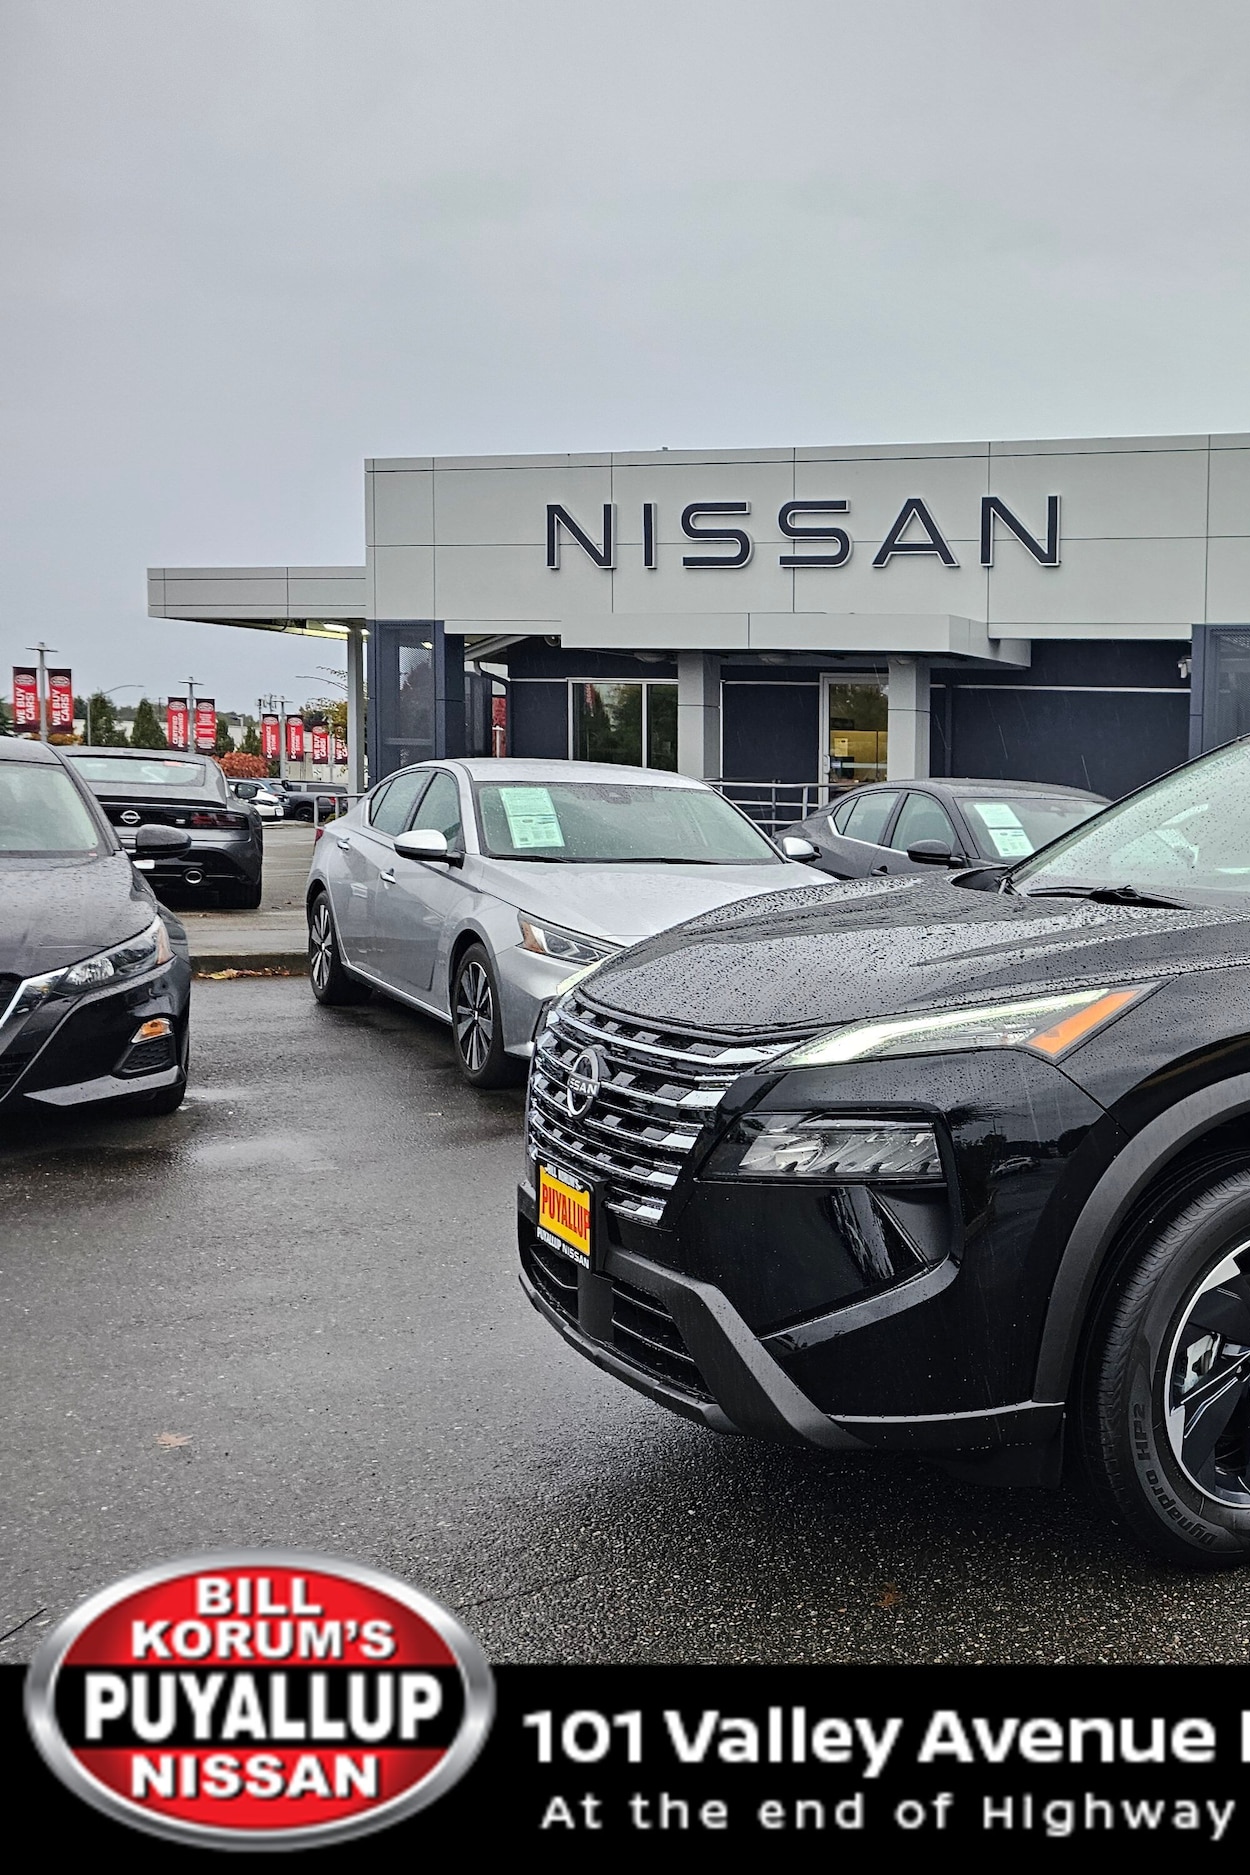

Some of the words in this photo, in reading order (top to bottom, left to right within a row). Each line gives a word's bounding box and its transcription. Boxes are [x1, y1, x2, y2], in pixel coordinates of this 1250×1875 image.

[546, 495, 1062, 569] NISSAN
[16, 687, 26, 708] BUY
[26, 692, 36, 721] CARS!
[52, 689, 61, 709] BUY
[61, 694, 70, 722] CARS!
[16, 709, 26, 725] WE
[52, 710, 61, 726] WE
[567, 1076, 598, 1096] SSAN
[541, 1182, 592, 1240] PUYALLUP
[562, 1243, 590, 1270] NISSAN
